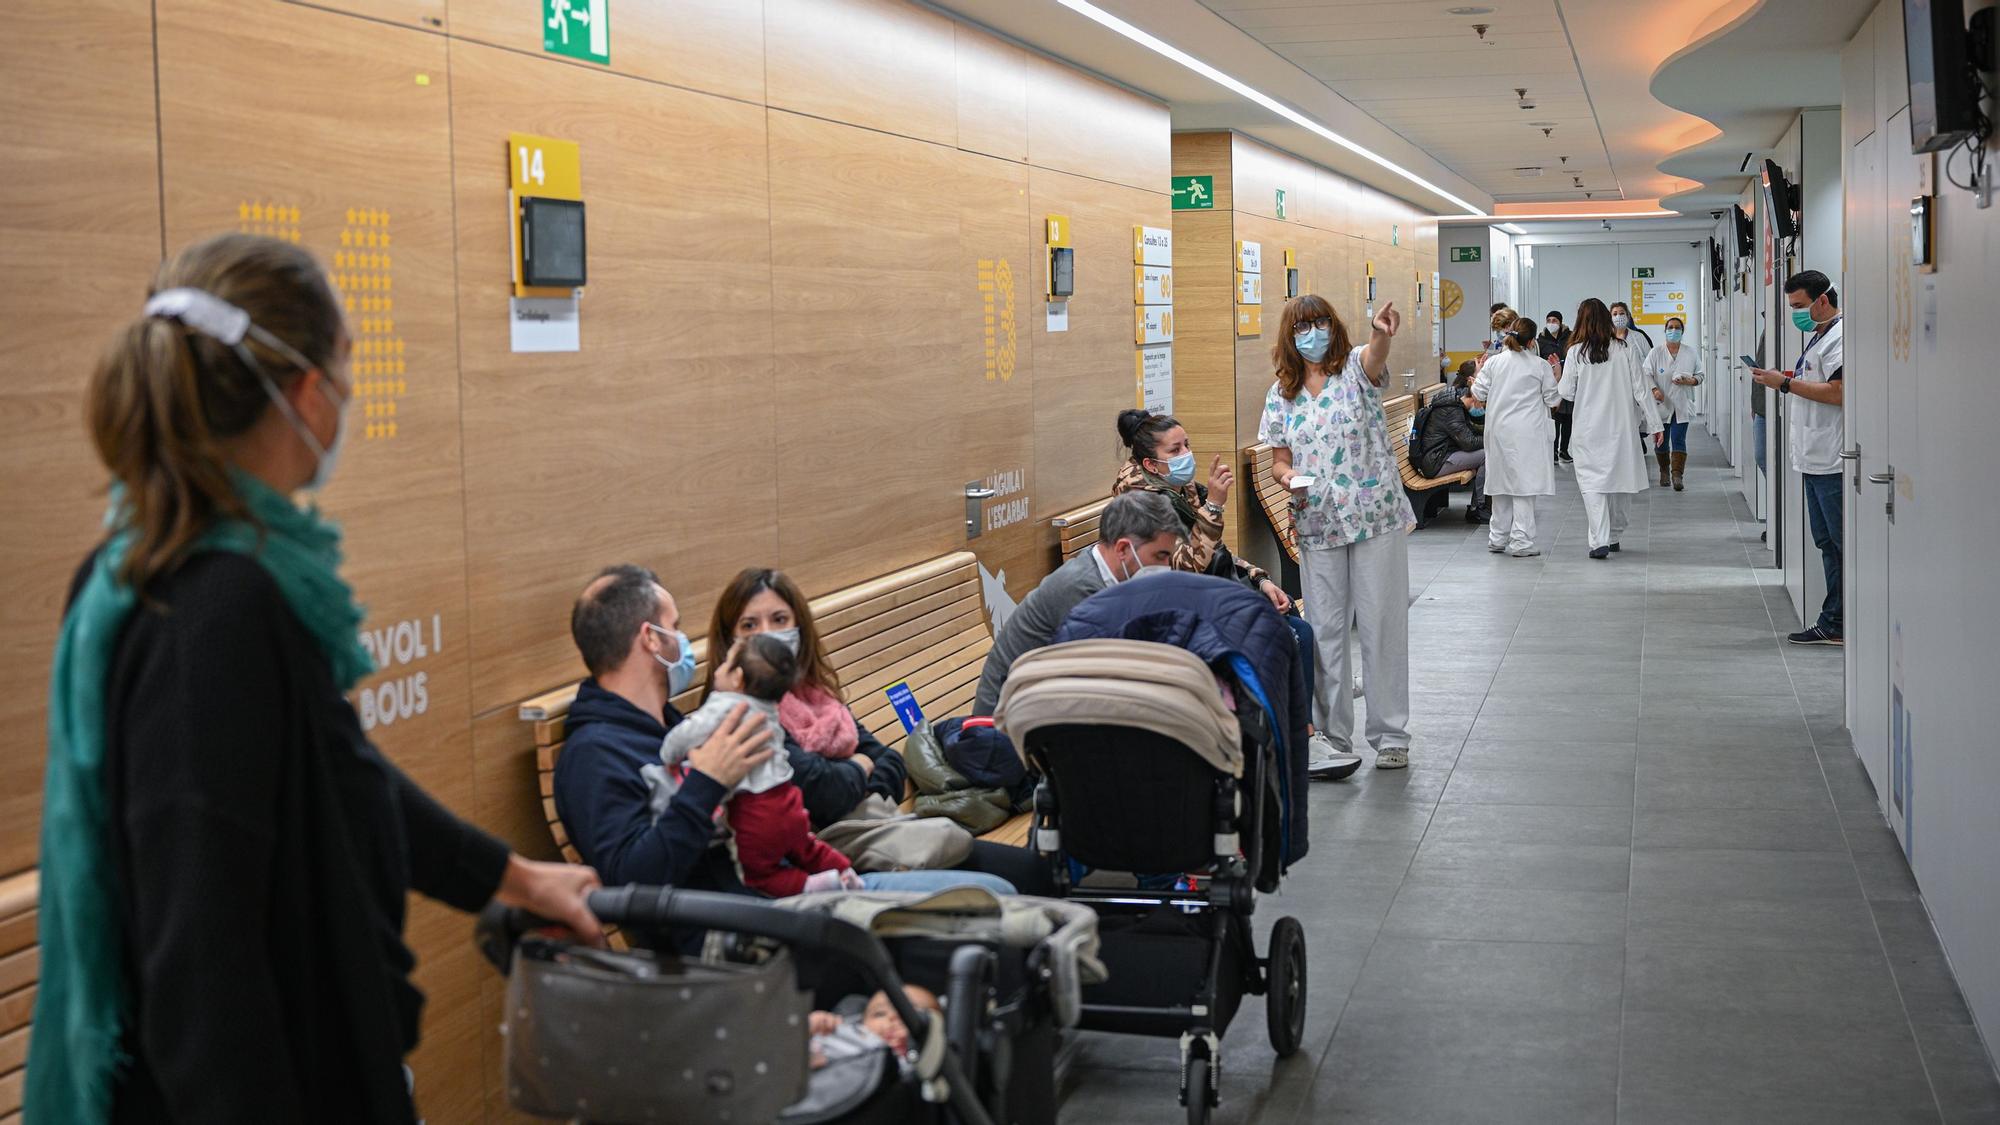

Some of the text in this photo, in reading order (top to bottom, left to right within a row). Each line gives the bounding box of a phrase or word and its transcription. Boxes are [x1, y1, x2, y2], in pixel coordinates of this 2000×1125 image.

[518, 146, 545, 186] 14
[1051, 220, 1060, 242] 13
[977, 256, 1017, 382] 13
[432, 613, 442, 653] I
[360, 671, 428, 730] BOUS
